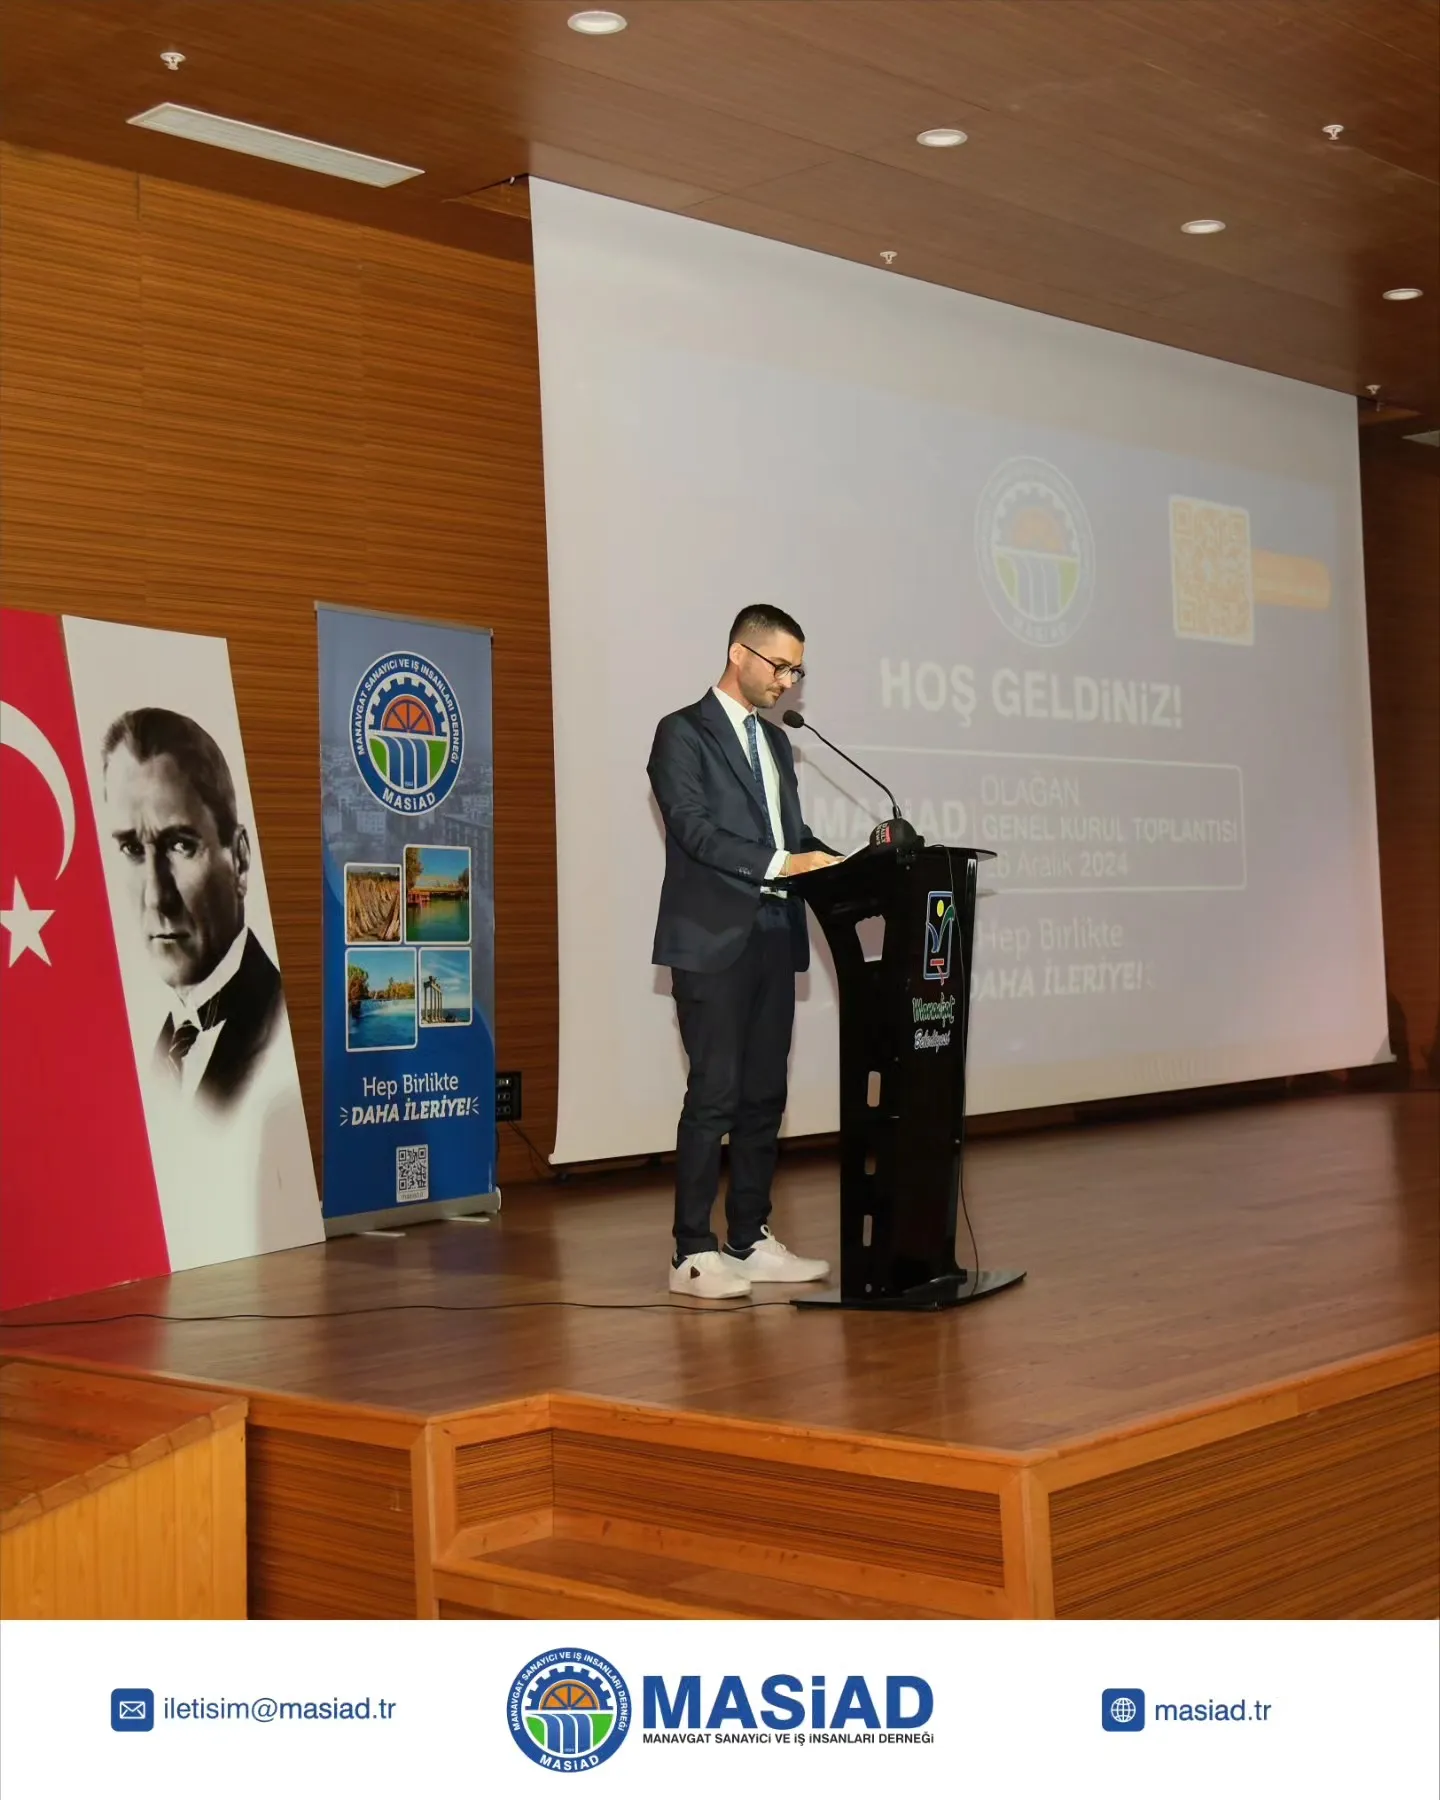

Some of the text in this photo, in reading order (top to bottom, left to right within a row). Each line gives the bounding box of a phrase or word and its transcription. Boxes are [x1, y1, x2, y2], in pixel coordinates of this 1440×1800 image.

[353, 690, 368, 756] MANAVGAT
[399, 658, 410, 668] VE
[879, 658, 976, 728] HOŞ
[981, 769, 1080, 808] OLAĞAN
[982, 814, 1238, 844] GENEL KURUL TOPLANTISI
[1080, 850, 1129, 877] 2024
[976, 916, 1124, 961] Hep Birlikte
[362, 1072, 459, 1099] Hep Birlikte
[351, 1095, 471, 1126] DAHA İLERİYE!
